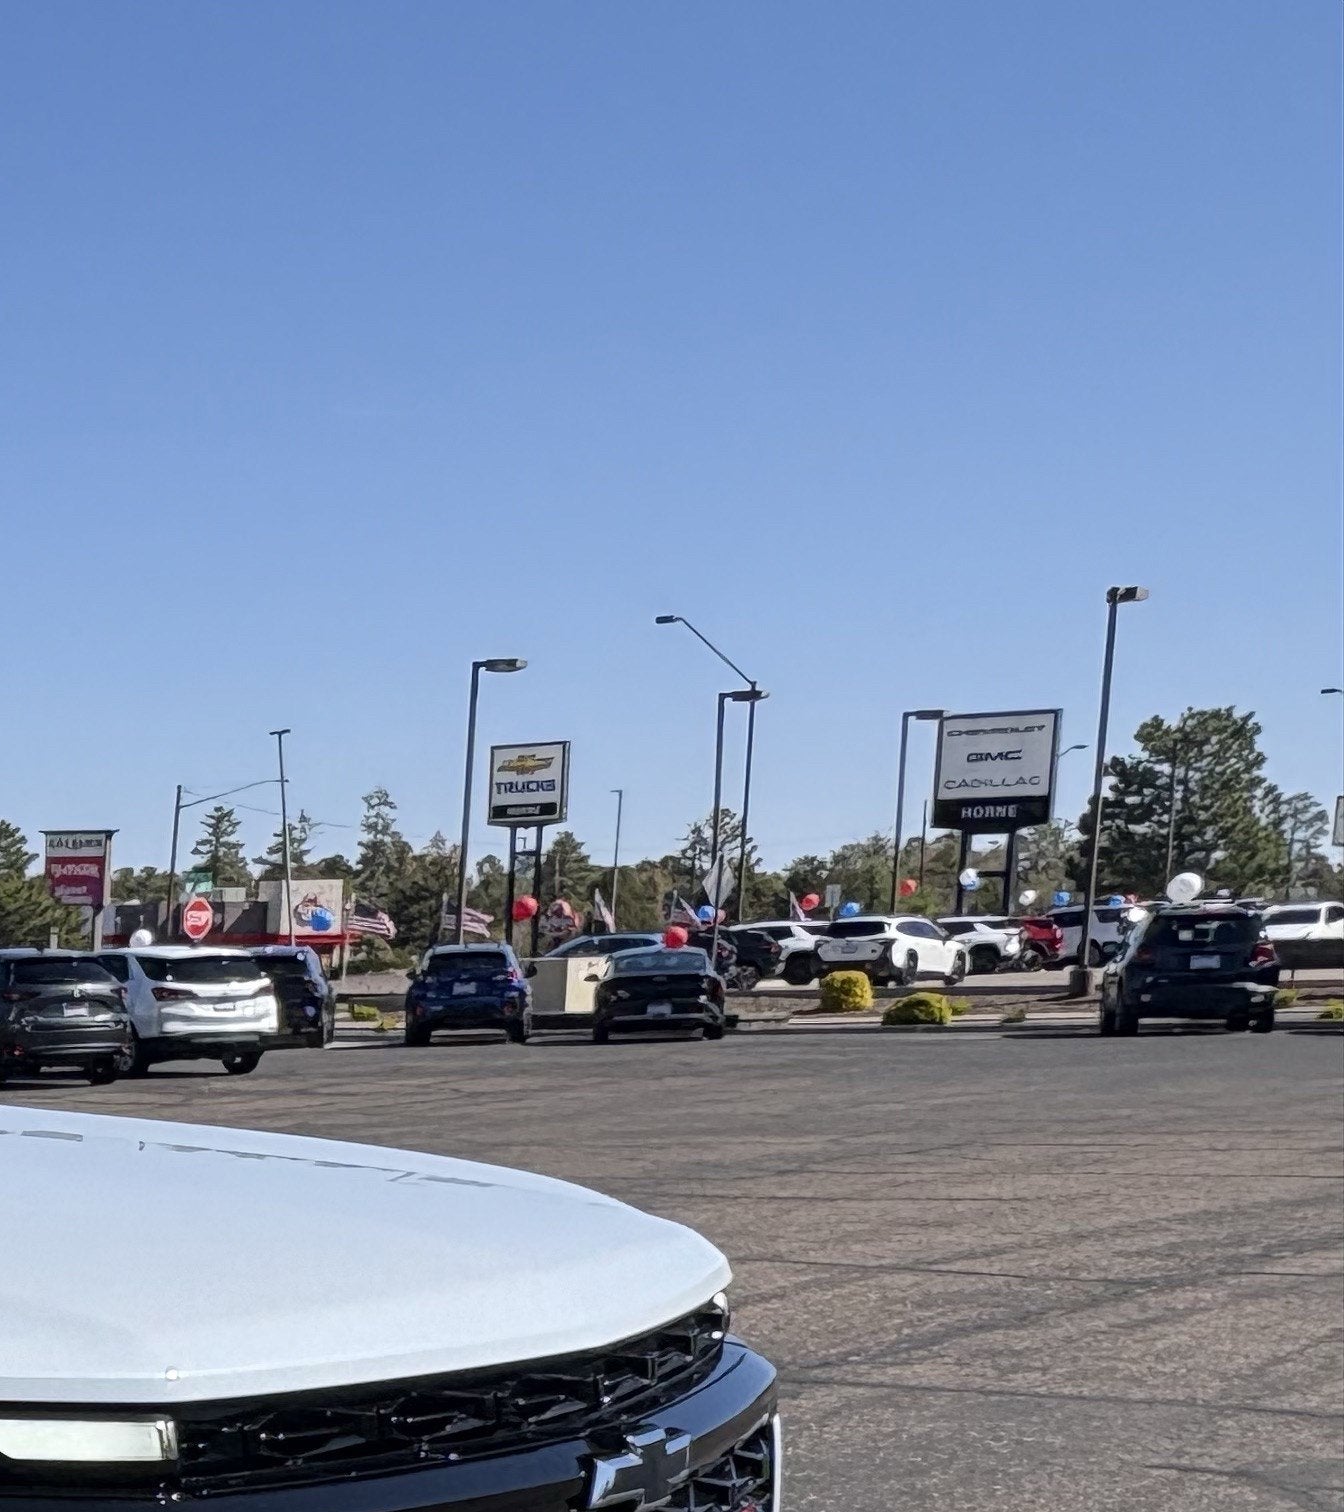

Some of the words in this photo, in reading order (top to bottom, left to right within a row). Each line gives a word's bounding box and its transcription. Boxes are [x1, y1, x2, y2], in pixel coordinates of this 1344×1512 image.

[967, 749, 1022, 763] GMC
[944, 776, 1040, 790] CADILLAC
[960, 804, 1018, 819] HORNE
